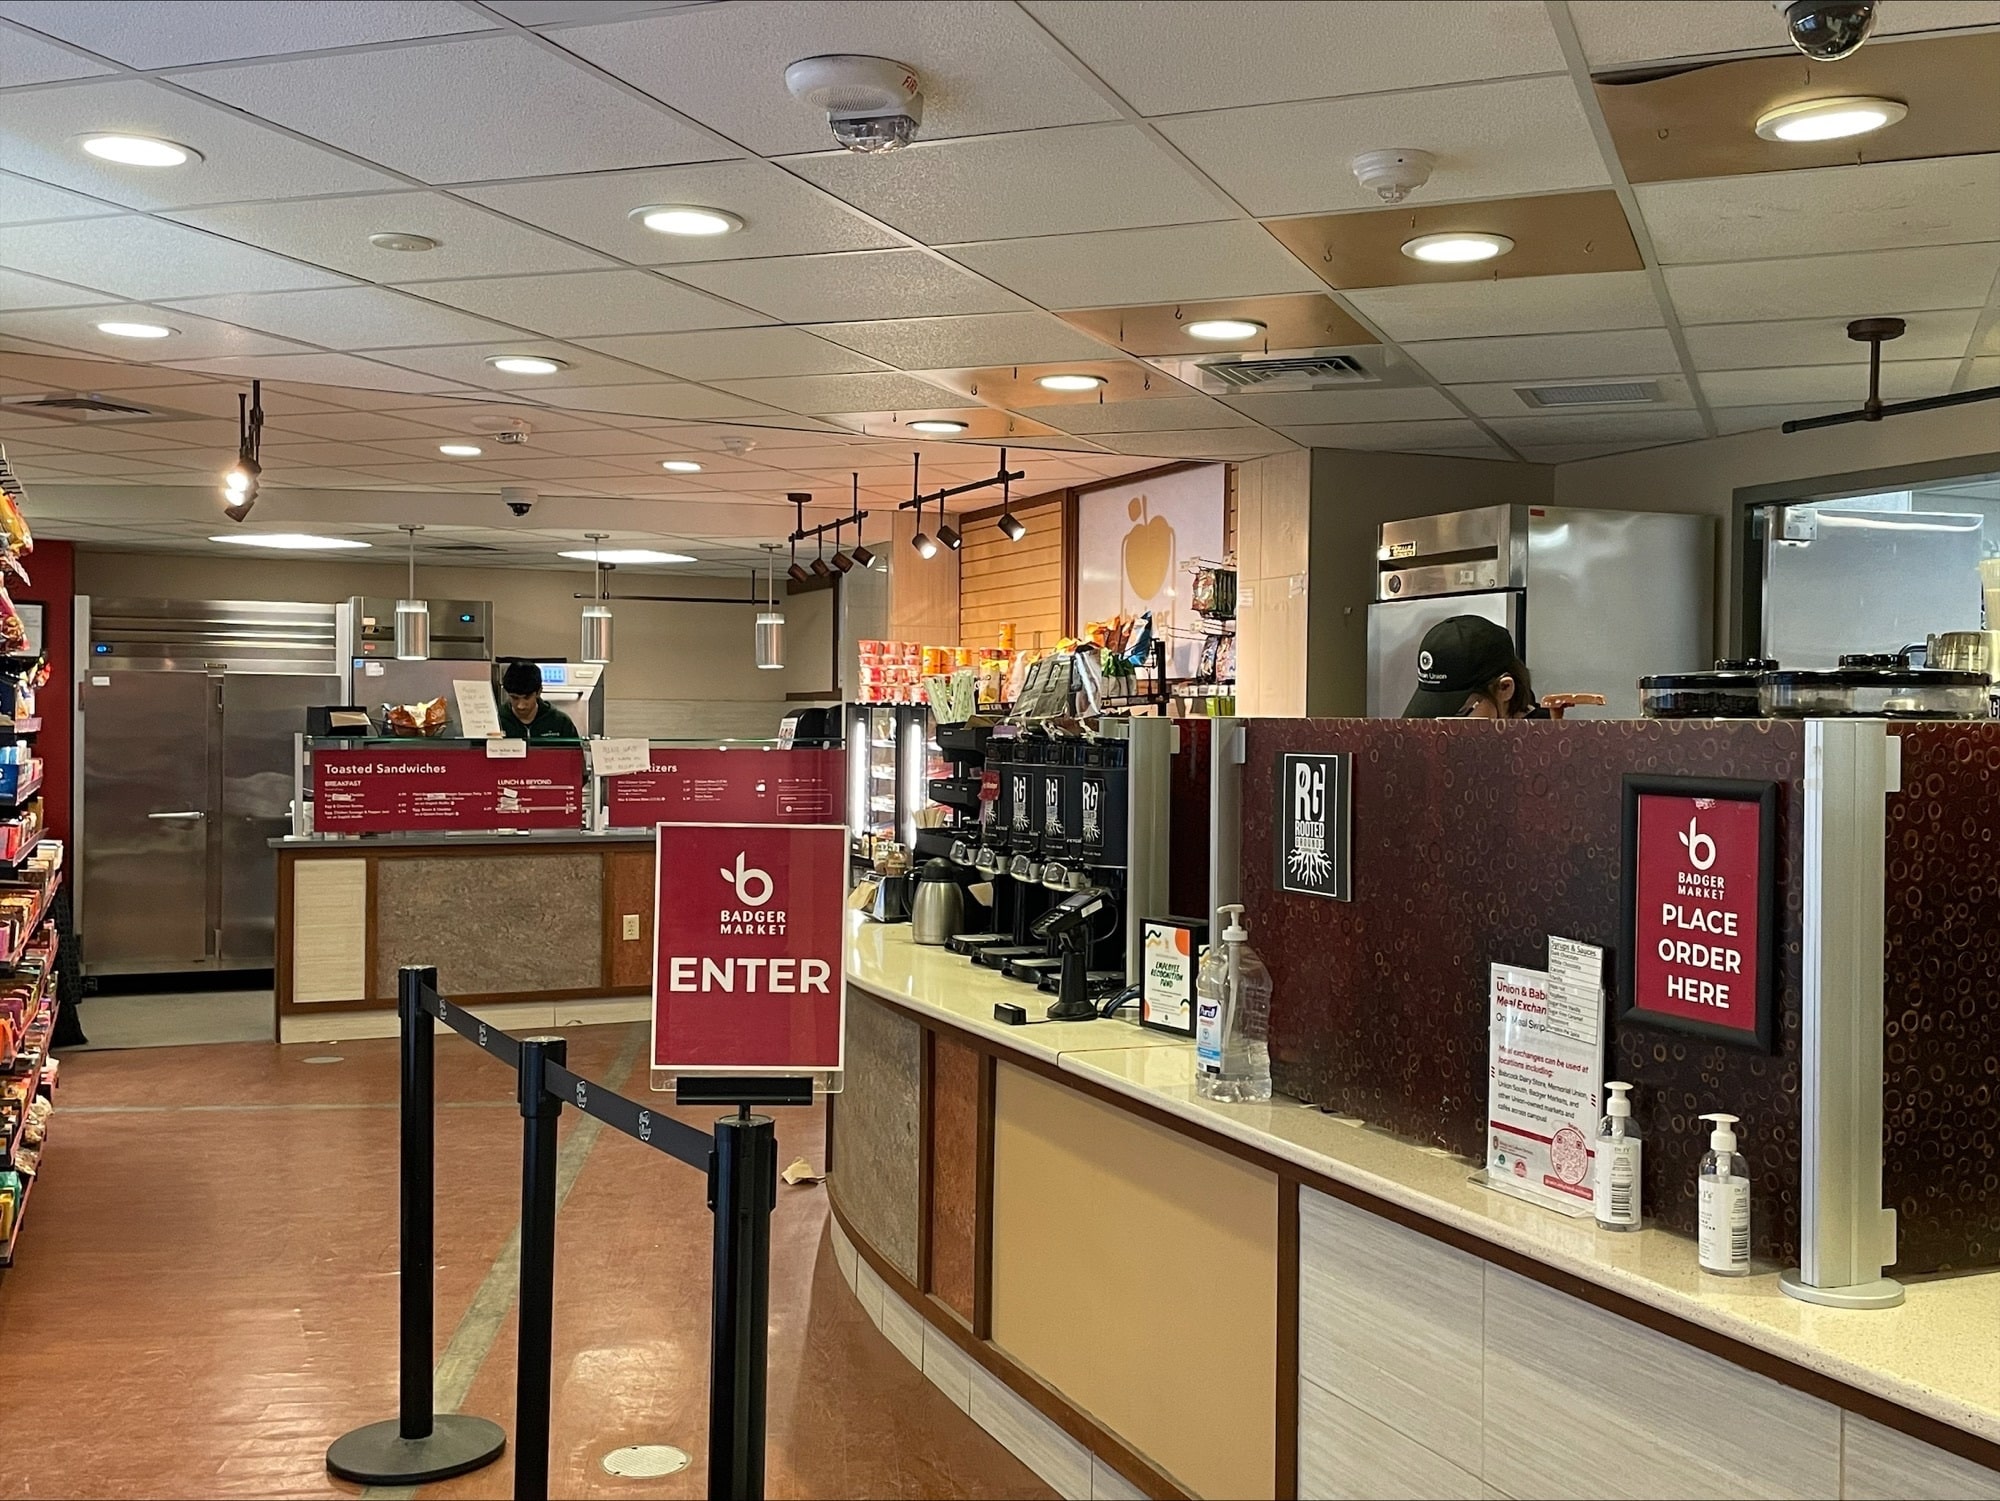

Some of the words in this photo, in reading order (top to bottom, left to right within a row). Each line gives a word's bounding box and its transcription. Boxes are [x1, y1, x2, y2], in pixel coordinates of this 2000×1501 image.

[325, 763, 372, 774] Toasted
[377, 763, 447, 774] Sandwiches
[1295, 762, 1326, 822] RG
[1295, 820, 1325, 838] ROOTED
[1678, 872, 1725, 889] BADGER
[1678, 885, 1725, 900] MARKET
[720, 910, 786, 923] BADGER
[1662, 903, 1738, 937] PLACE
[720, 924, 786, 935] MARKET
[1658, 938, 1741, 974] ORDER
[1151, 969, 1184, 981] RECOGNITION
[1155, 961, 1180, 973] EMPLOYEE
[670, 957, 831, 994] ENTER
[1160, 979, 1174, 989] FUND
[1497, 981, 1520, 995] Union
[1521, 986, 1527, 997] &
[1668, 974, 1730, 1009] HERE
[1497, 996, 1516, 1007] Meal
[1517, 1000, 1547, 1015] Exchan
[1498, 1056, 1524, 1070] locations
[1513, 1049, 1544, 1063] exchanges
[1545, 1058, 1556, 1066] can
[1556, 1058, 1565, 1067] be
[1565, 1063, 1581, 1072] used
